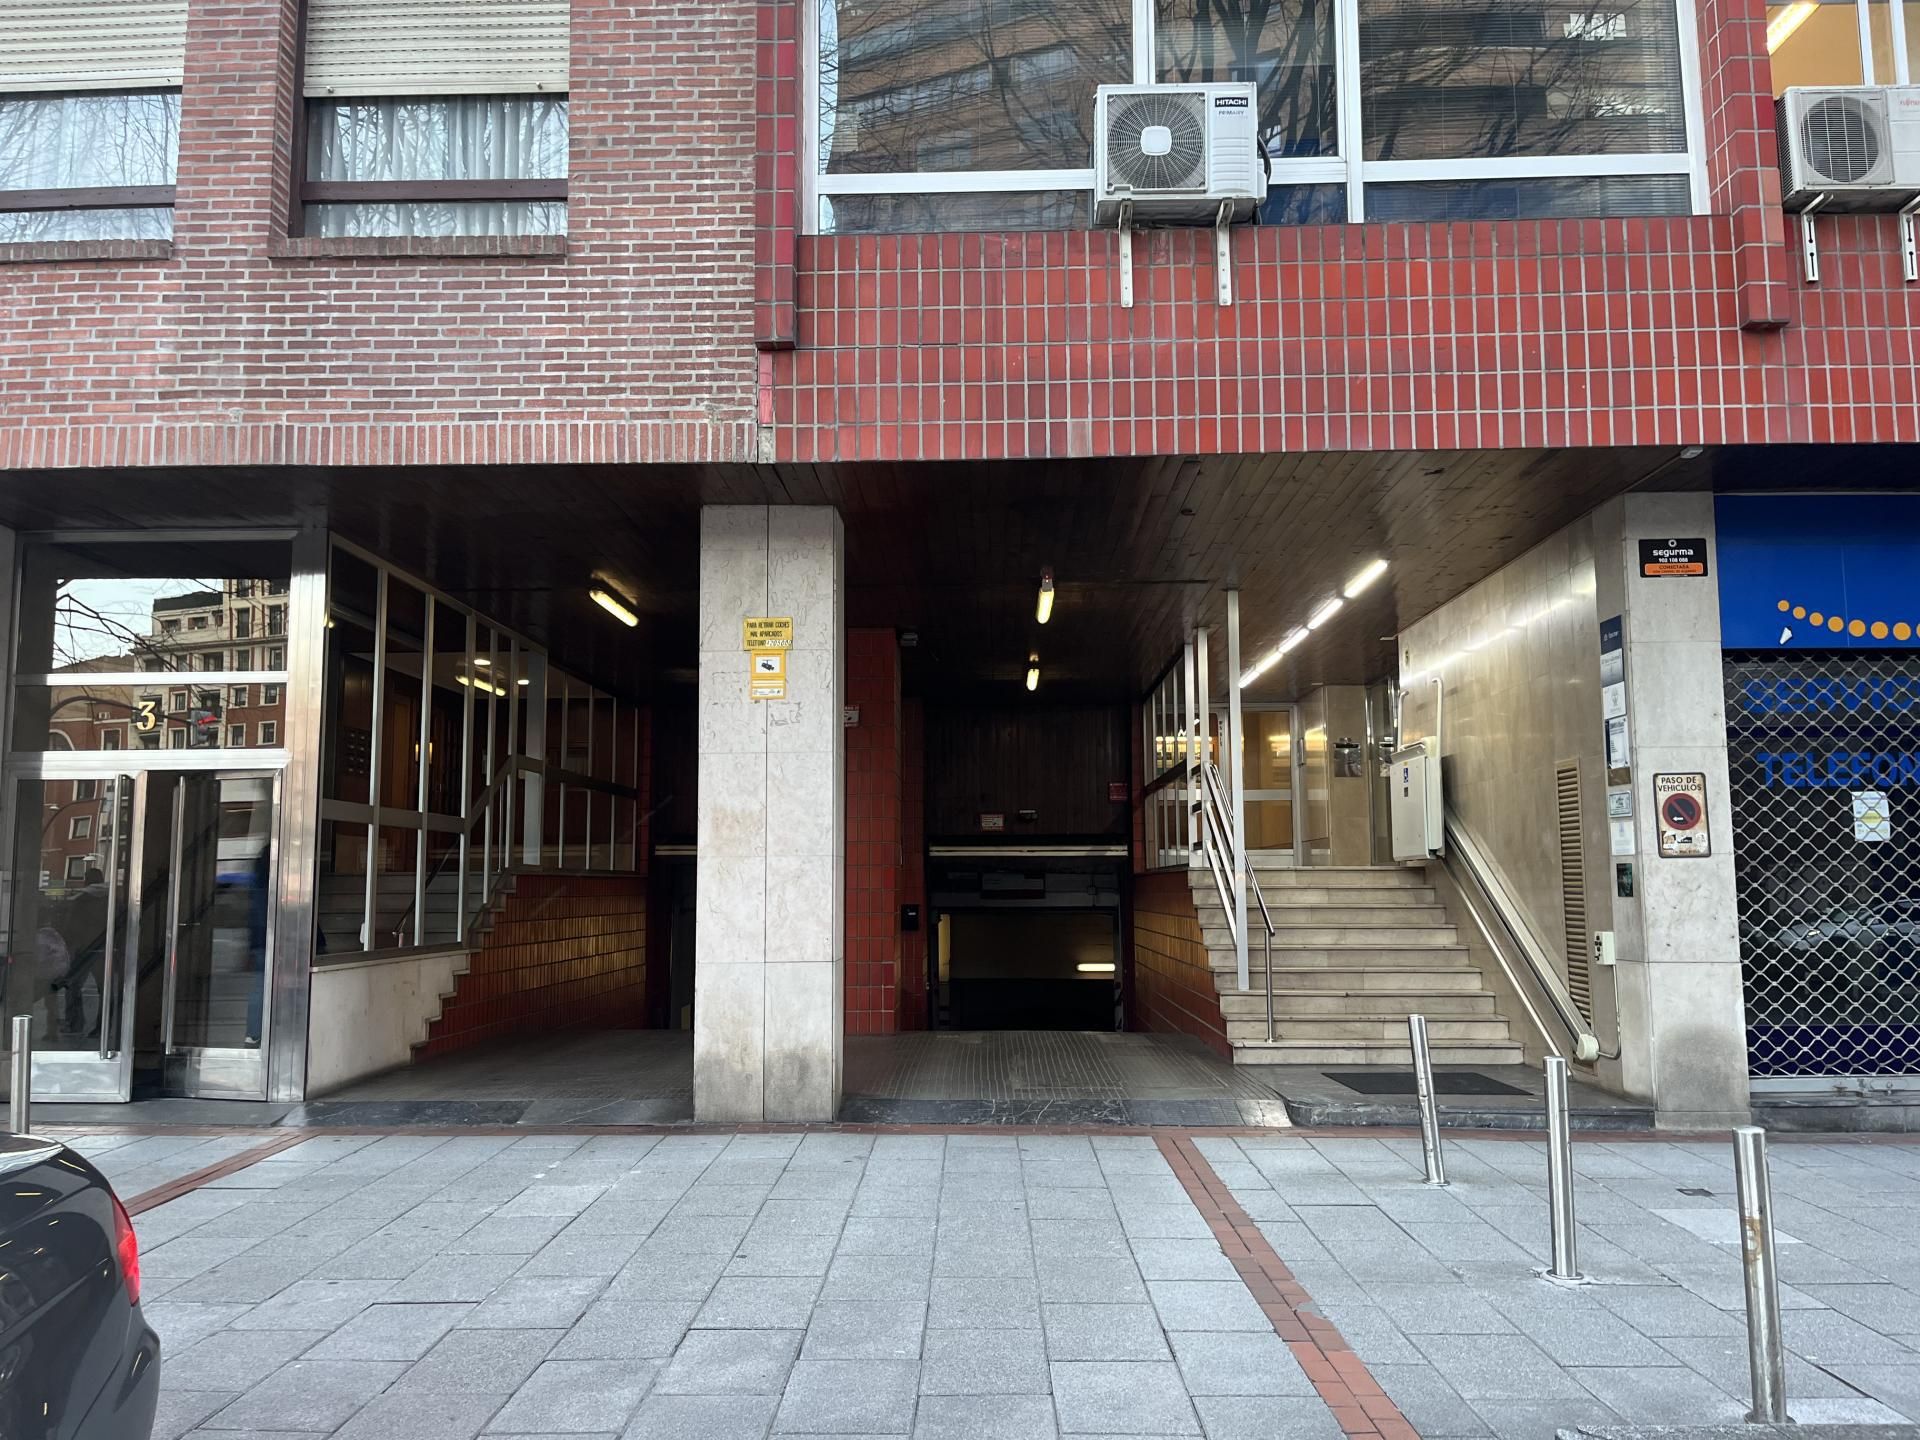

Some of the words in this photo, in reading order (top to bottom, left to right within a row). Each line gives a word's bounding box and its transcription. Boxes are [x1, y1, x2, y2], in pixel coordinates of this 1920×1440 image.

[1216, 98, 1247, 106] HITACHI
[1652, 549, 1694, 557] segurma
[746, 621, 757, 629] PARA
[1743, 677, 1920, 713] SERVIC
[136, 701, 156, 731] 3
[1661, 776, 1683, 784] PASO
[1686, 776, 1697, 784] DE
[1658, 784, 1702, 792] VEHICULOS
